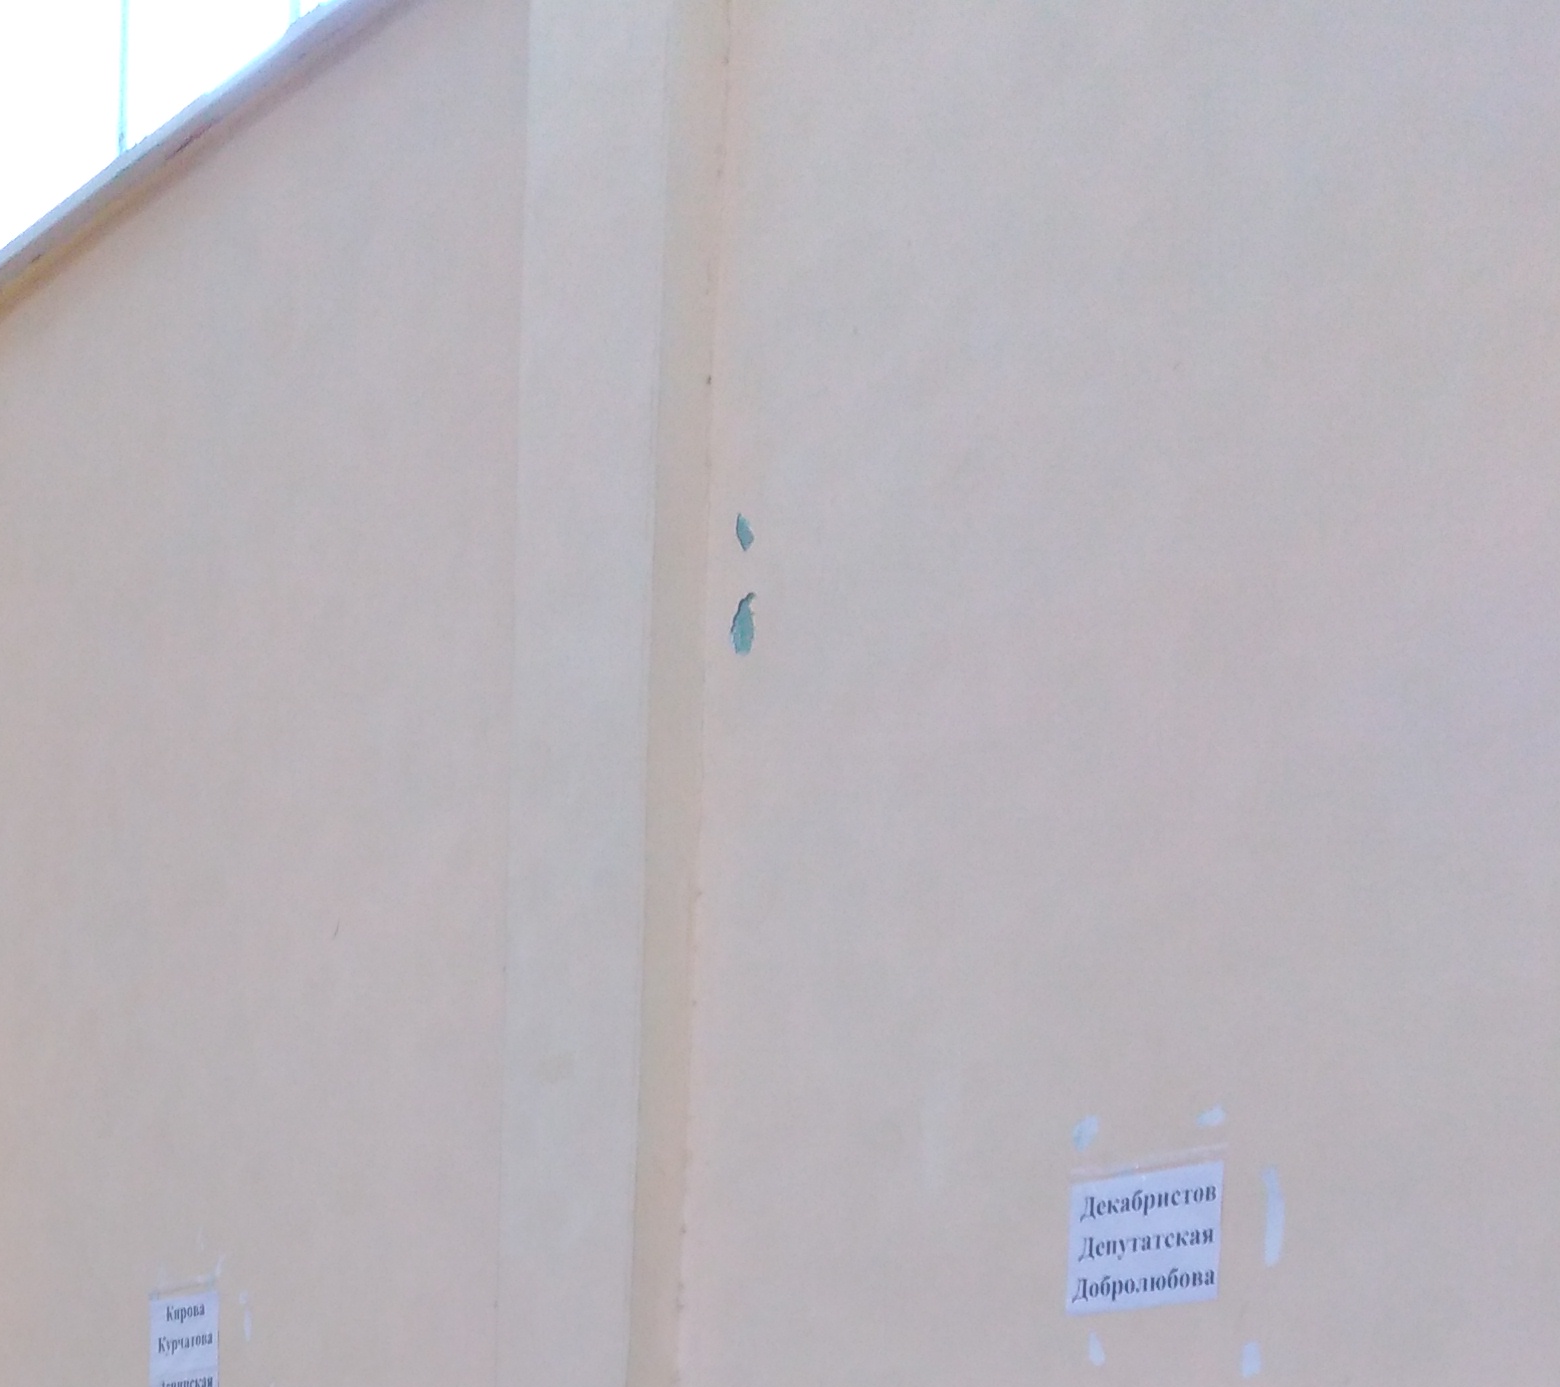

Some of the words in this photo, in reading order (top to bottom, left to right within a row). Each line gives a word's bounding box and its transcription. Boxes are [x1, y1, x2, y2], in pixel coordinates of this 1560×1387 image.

[1080, 1186, 1217, 1222] Декабристов
[1078, 1228, 1214, 1262] Депутатская
[1072, 1267, 1215, 1303] Добролюбова
[166, 1303, 206, 1323] Кирова
[158, 1333, 213, 1356] Курчатова
